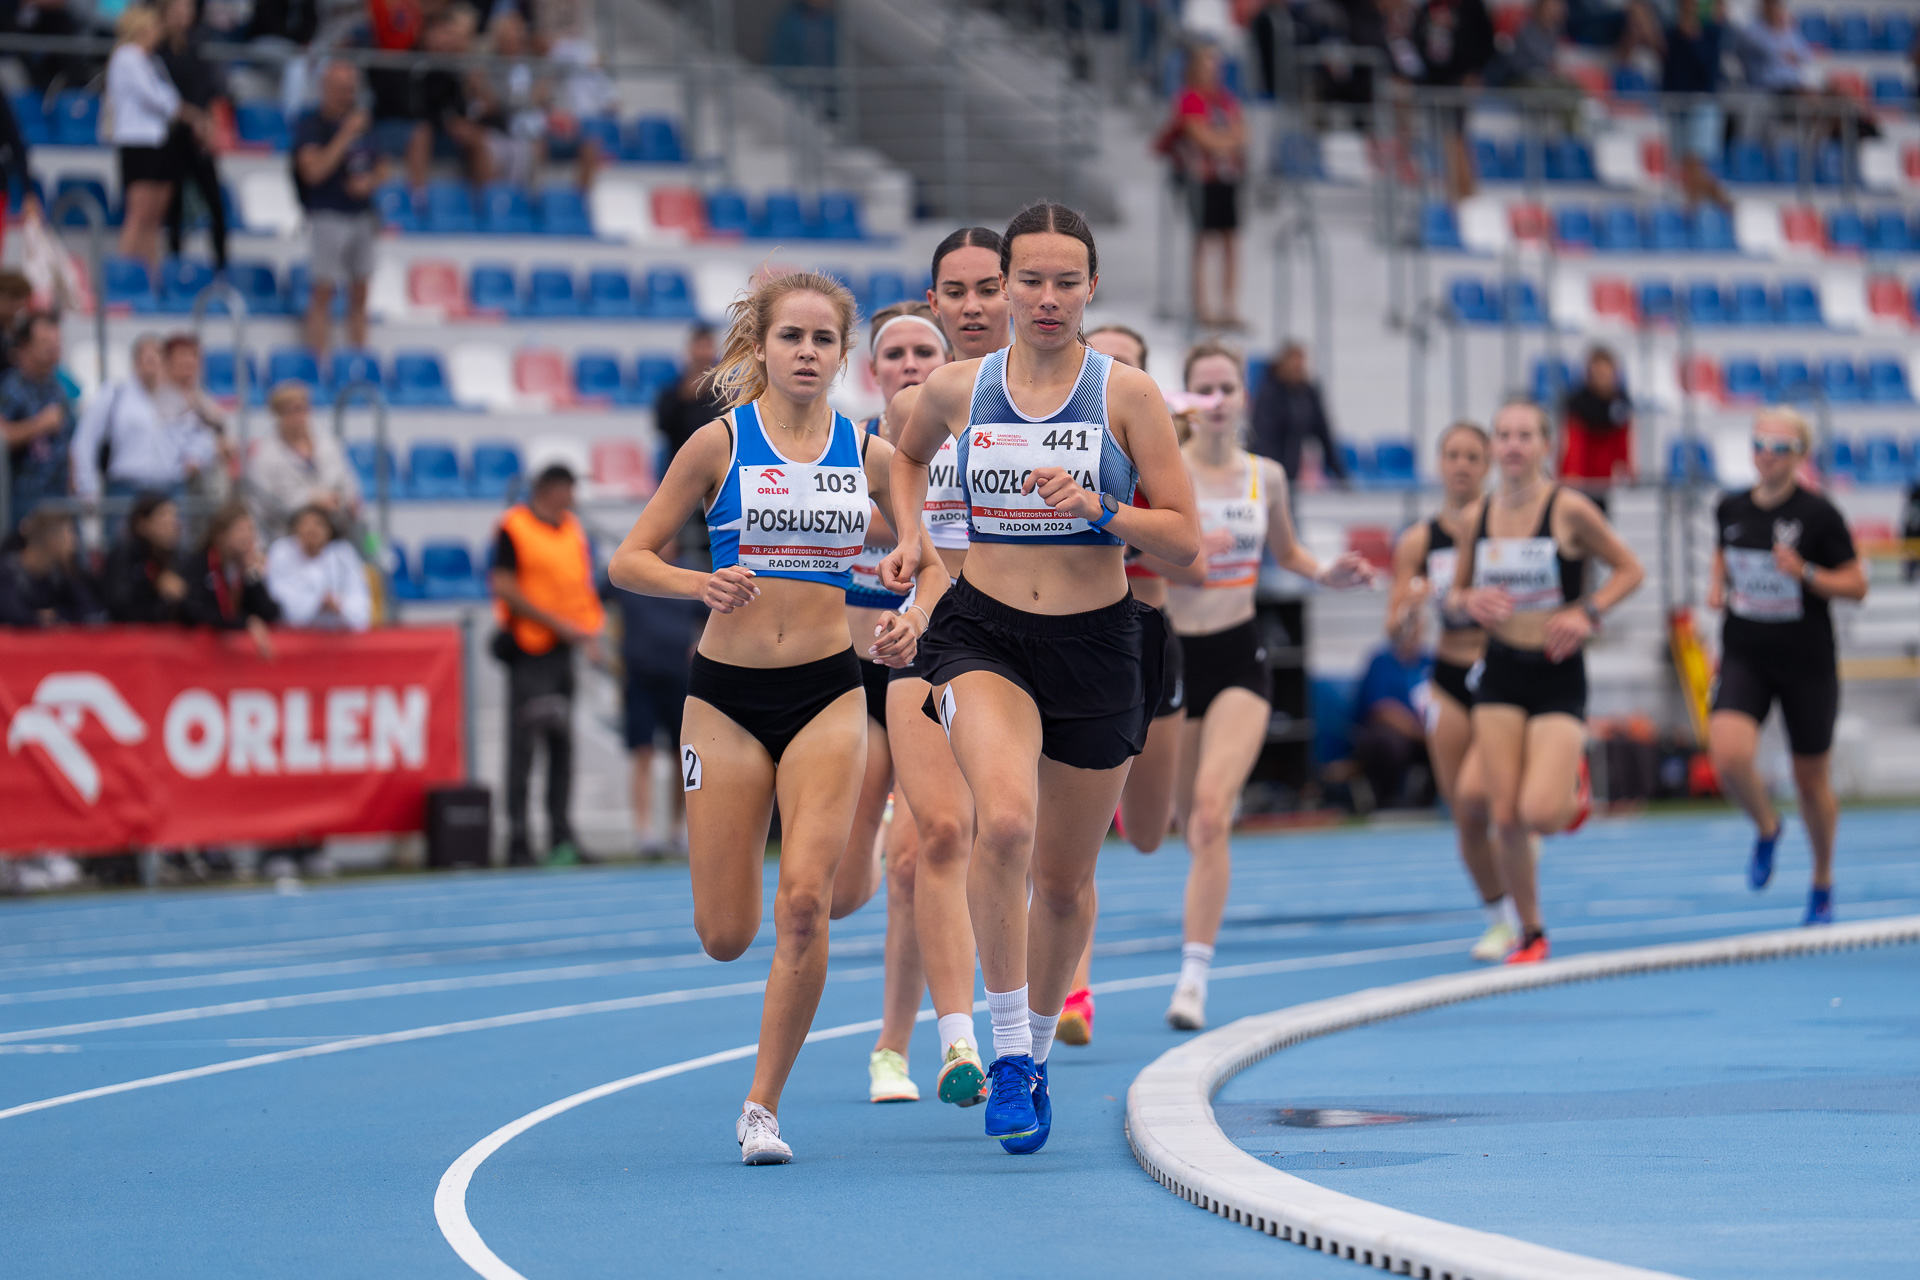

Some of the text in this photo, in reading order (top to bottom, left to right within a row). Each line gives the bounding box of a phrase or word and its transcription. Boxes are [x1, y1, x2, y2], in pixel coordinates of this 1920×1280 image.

[1042, 429, 1089, 451] 441
[757, 487, 789, 495] ORLEN
[813, 473, 857, 494] 103
[983, 508, 994, 516] 78.
[994, 509, 1008, 517] PZLA
[1009, 510, 1053, 518] Mistrzostwa
[746, 508, 865, 534] POSŁUSZNA
[999, 522, 1072, 531] RADOM 2024
[751, 546, 762, 554] 78.
[781, 547, 822, 555] Mistrzostwa
[823, 548, 843, 556] Polski
[844, 548, 855, 556] U20
[768, 559, 839, 569] RADOM 2024
[164, 686, 428, 779] ORLEN
[685, 748, 697, 787] 2
